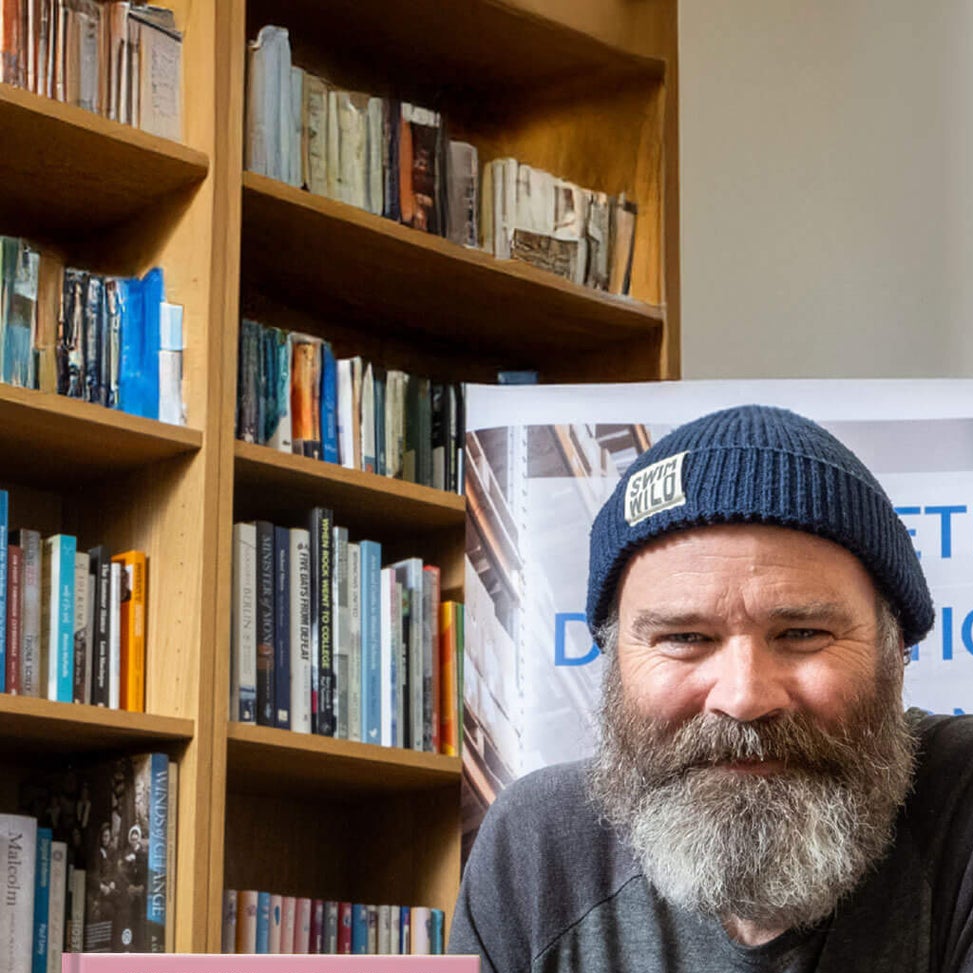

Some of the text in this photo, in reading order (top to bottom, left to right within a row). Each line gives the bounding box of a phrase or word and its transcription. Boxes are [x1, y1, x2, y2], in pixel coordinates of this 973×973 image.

[630, 459, 678, 497] SWIM
[261, 534, 274, 596] MINISTER
[299, 552, 309, 571] FIVE
[299, 573, 309, 598] DAYS
[320, 518, 330, 671] WHEN ROCK WENT TO COLLEGE
[242, 587, 253, 630] BERLIN
[299, 598, 309, 626] FROM
[299, 626, 309, 662] DEFEAT
[151, 770, 167, 917] WINDS of CHANGE
[6, 832, 24, 907] Malcolm
